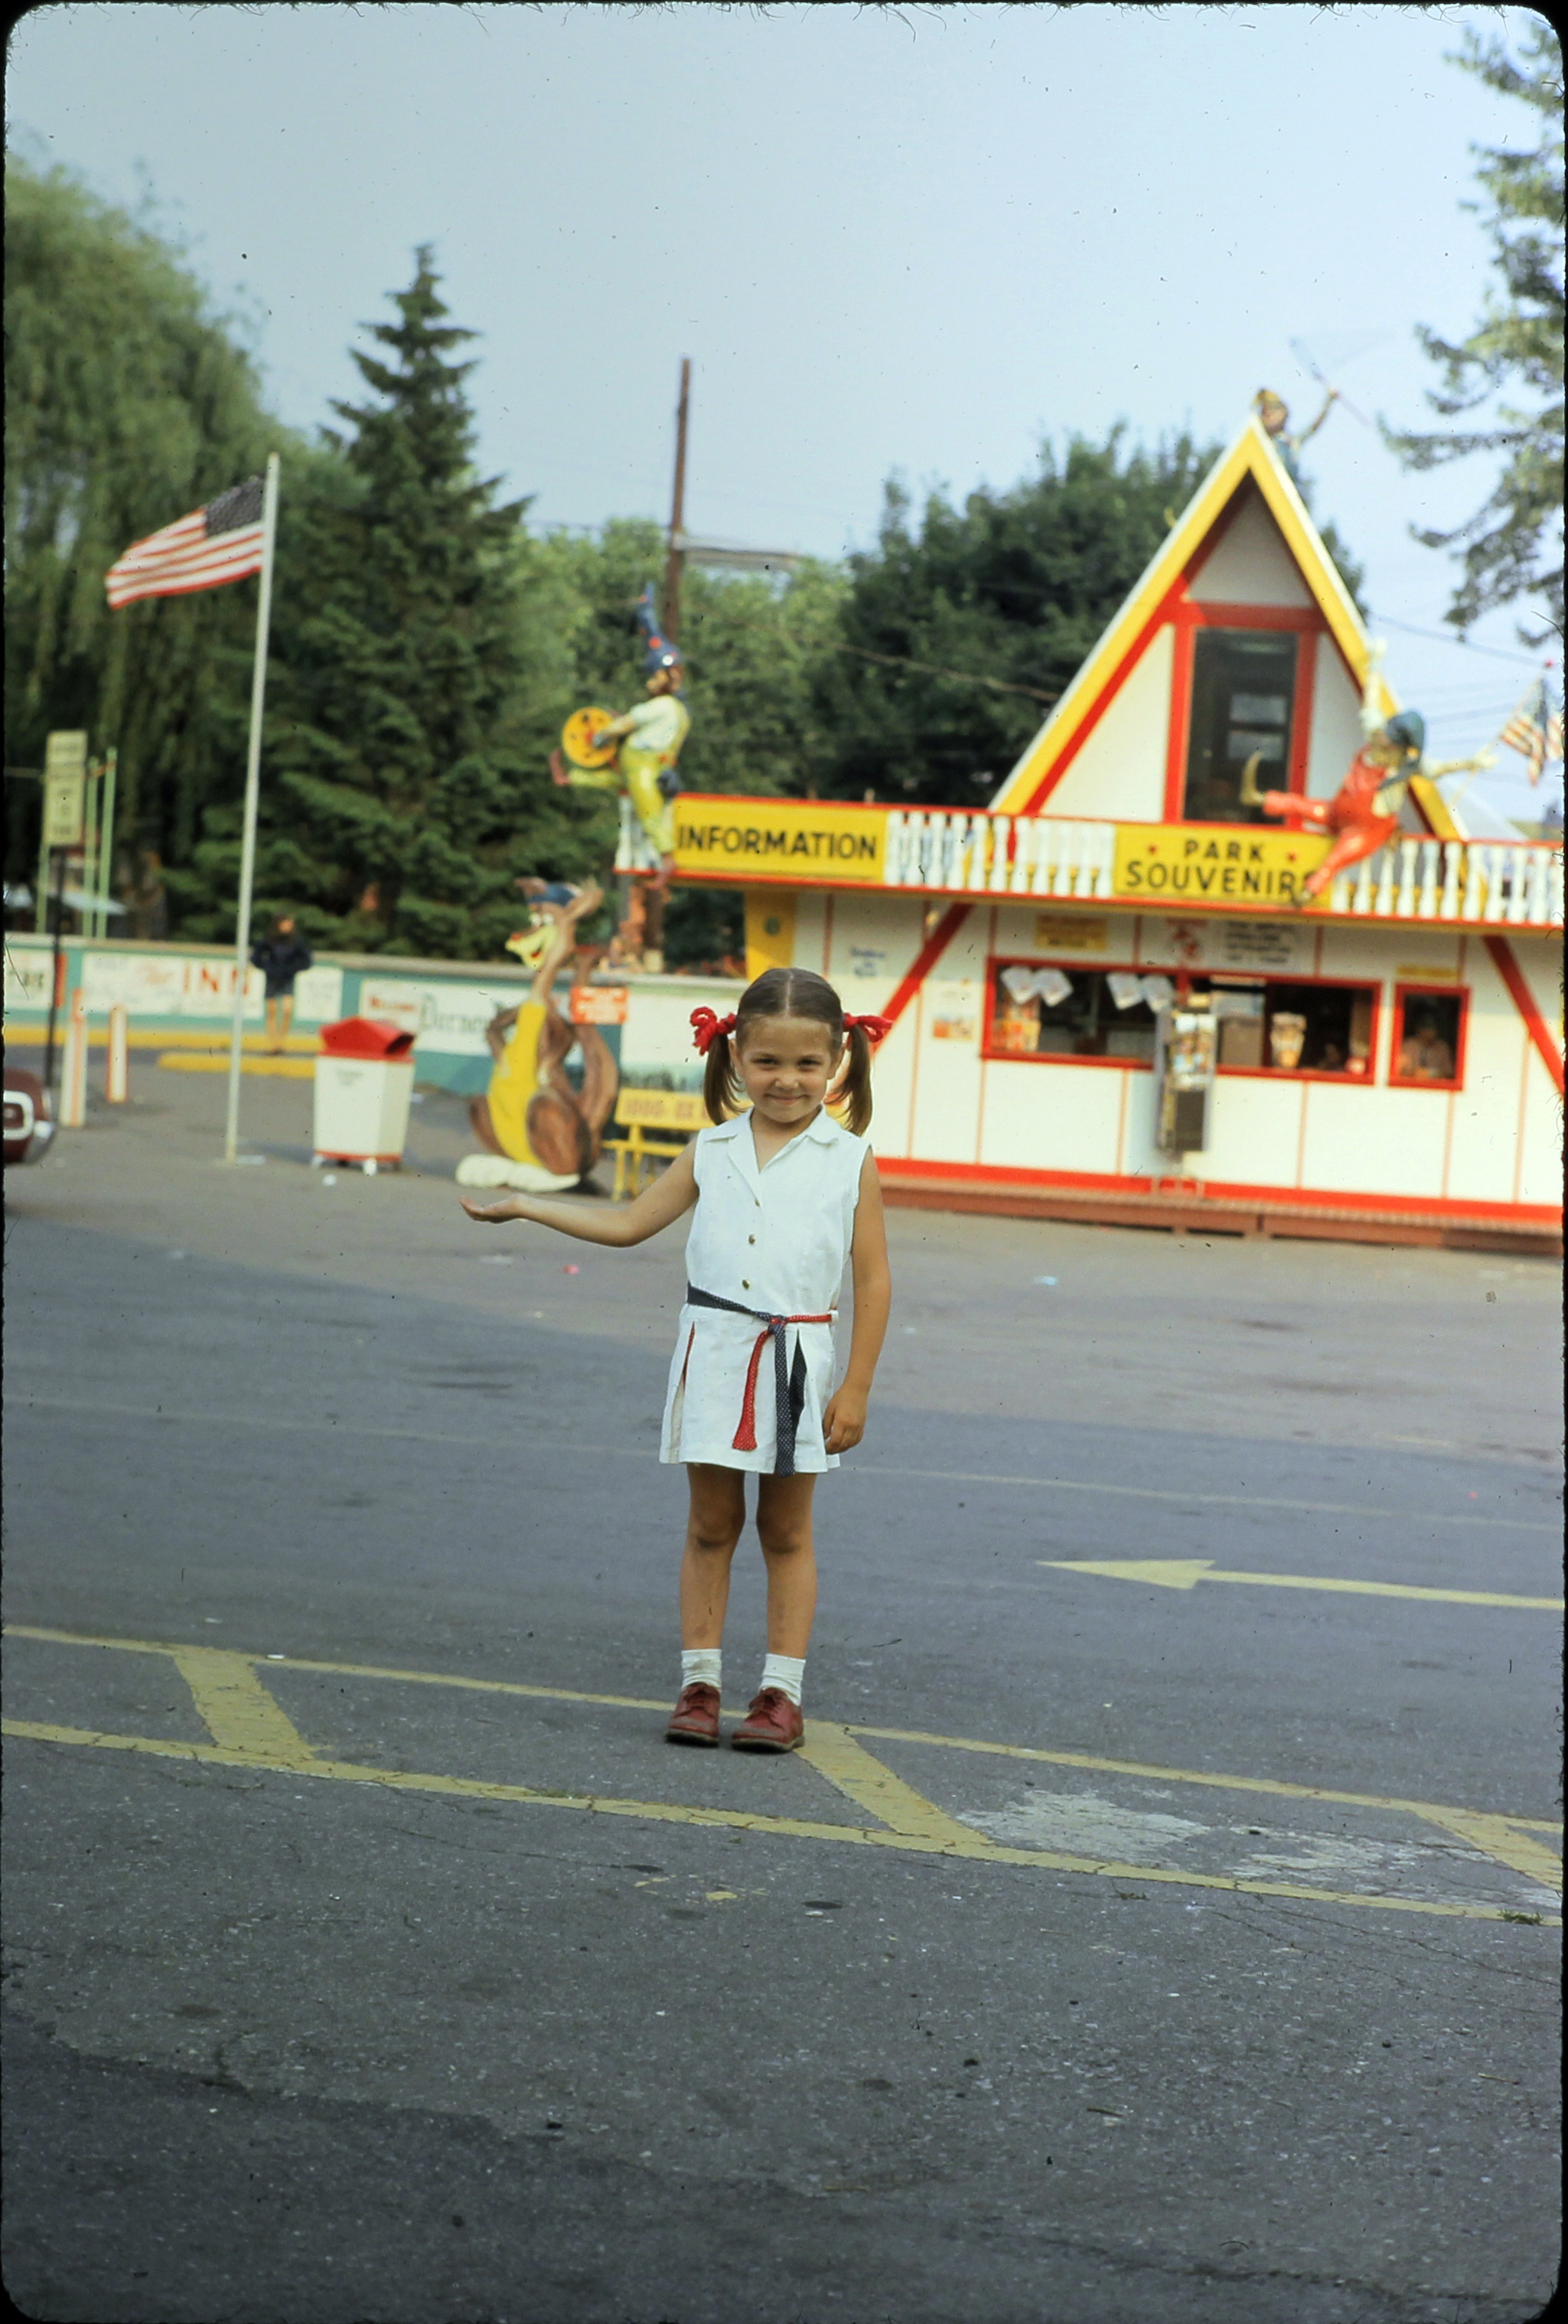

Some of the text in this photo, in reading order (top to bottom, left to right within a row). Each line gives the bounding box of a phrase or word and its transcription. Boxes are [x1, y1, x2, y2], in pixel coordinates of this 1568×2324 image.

[678, 825, 876, 860] INFORMATION
[1185, 840, 1263, 861] PARK
[1126, 861, 1316, 894] SOUVENIR
